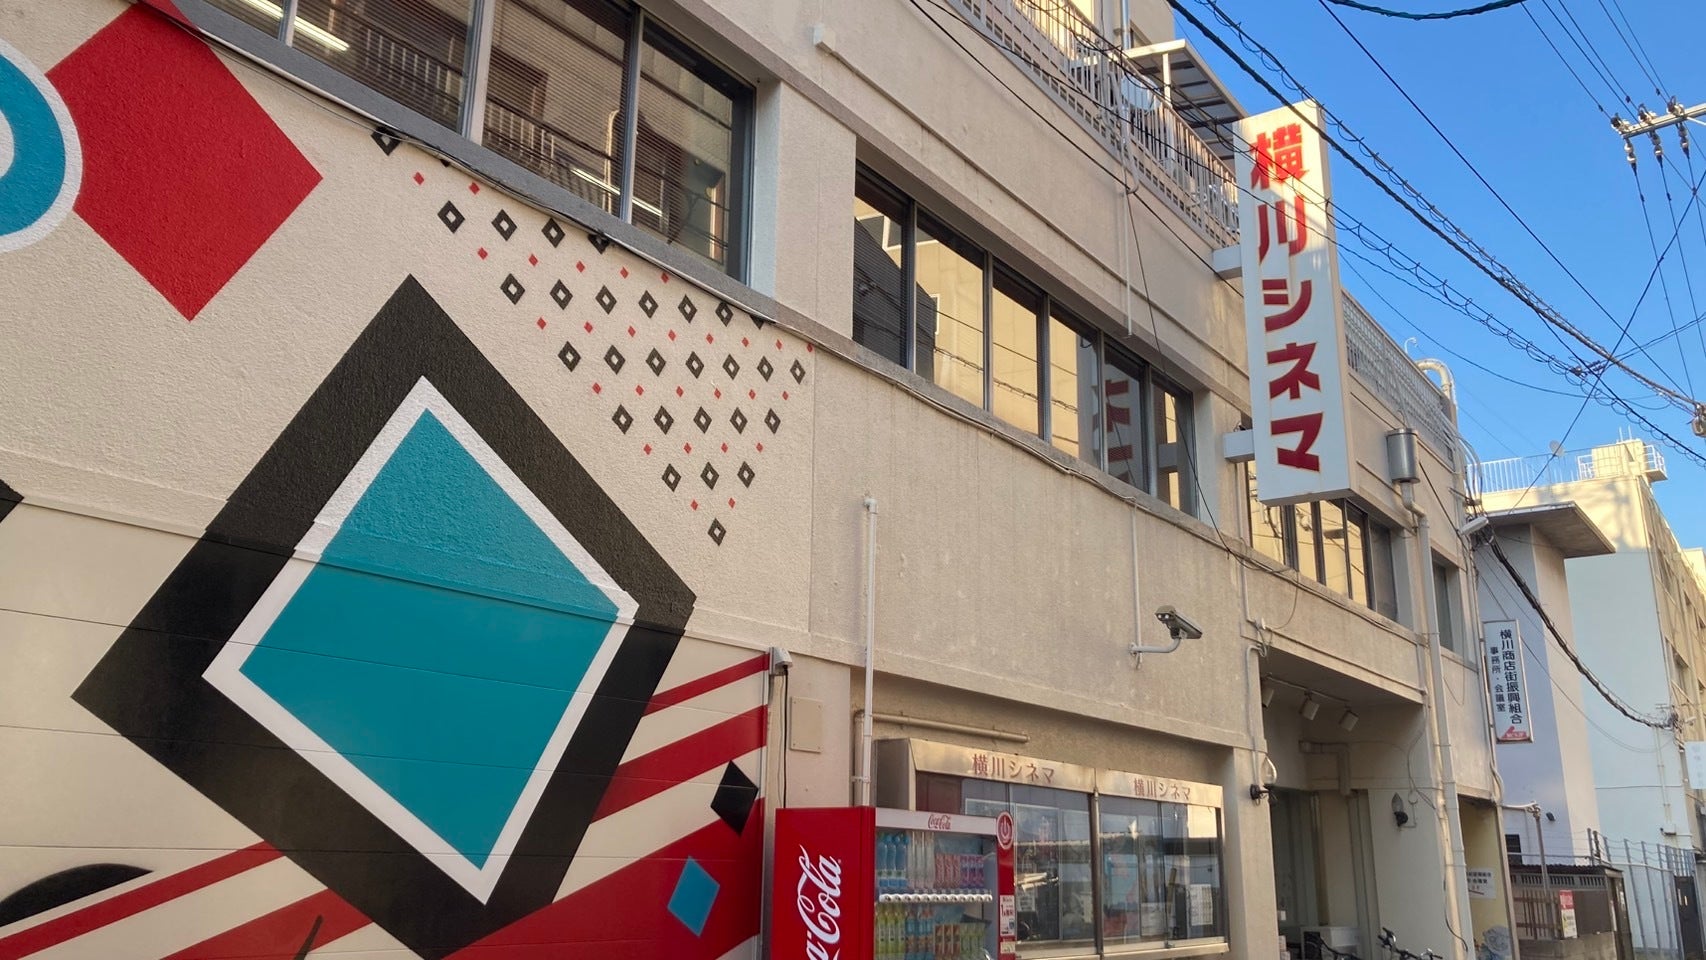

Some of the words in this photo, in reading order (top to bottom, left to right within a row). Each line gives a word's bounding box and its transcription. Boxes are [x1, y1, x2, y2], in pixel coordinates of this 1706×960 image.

[1250, 121, 1324, 472] 横川シネマ
[1500, 629, 1523, 724] 横川商店街振興組合
[971, 753, 1055, 784] 横川シネマ
[1133, 778, 1191, 800] 横川シネマ
